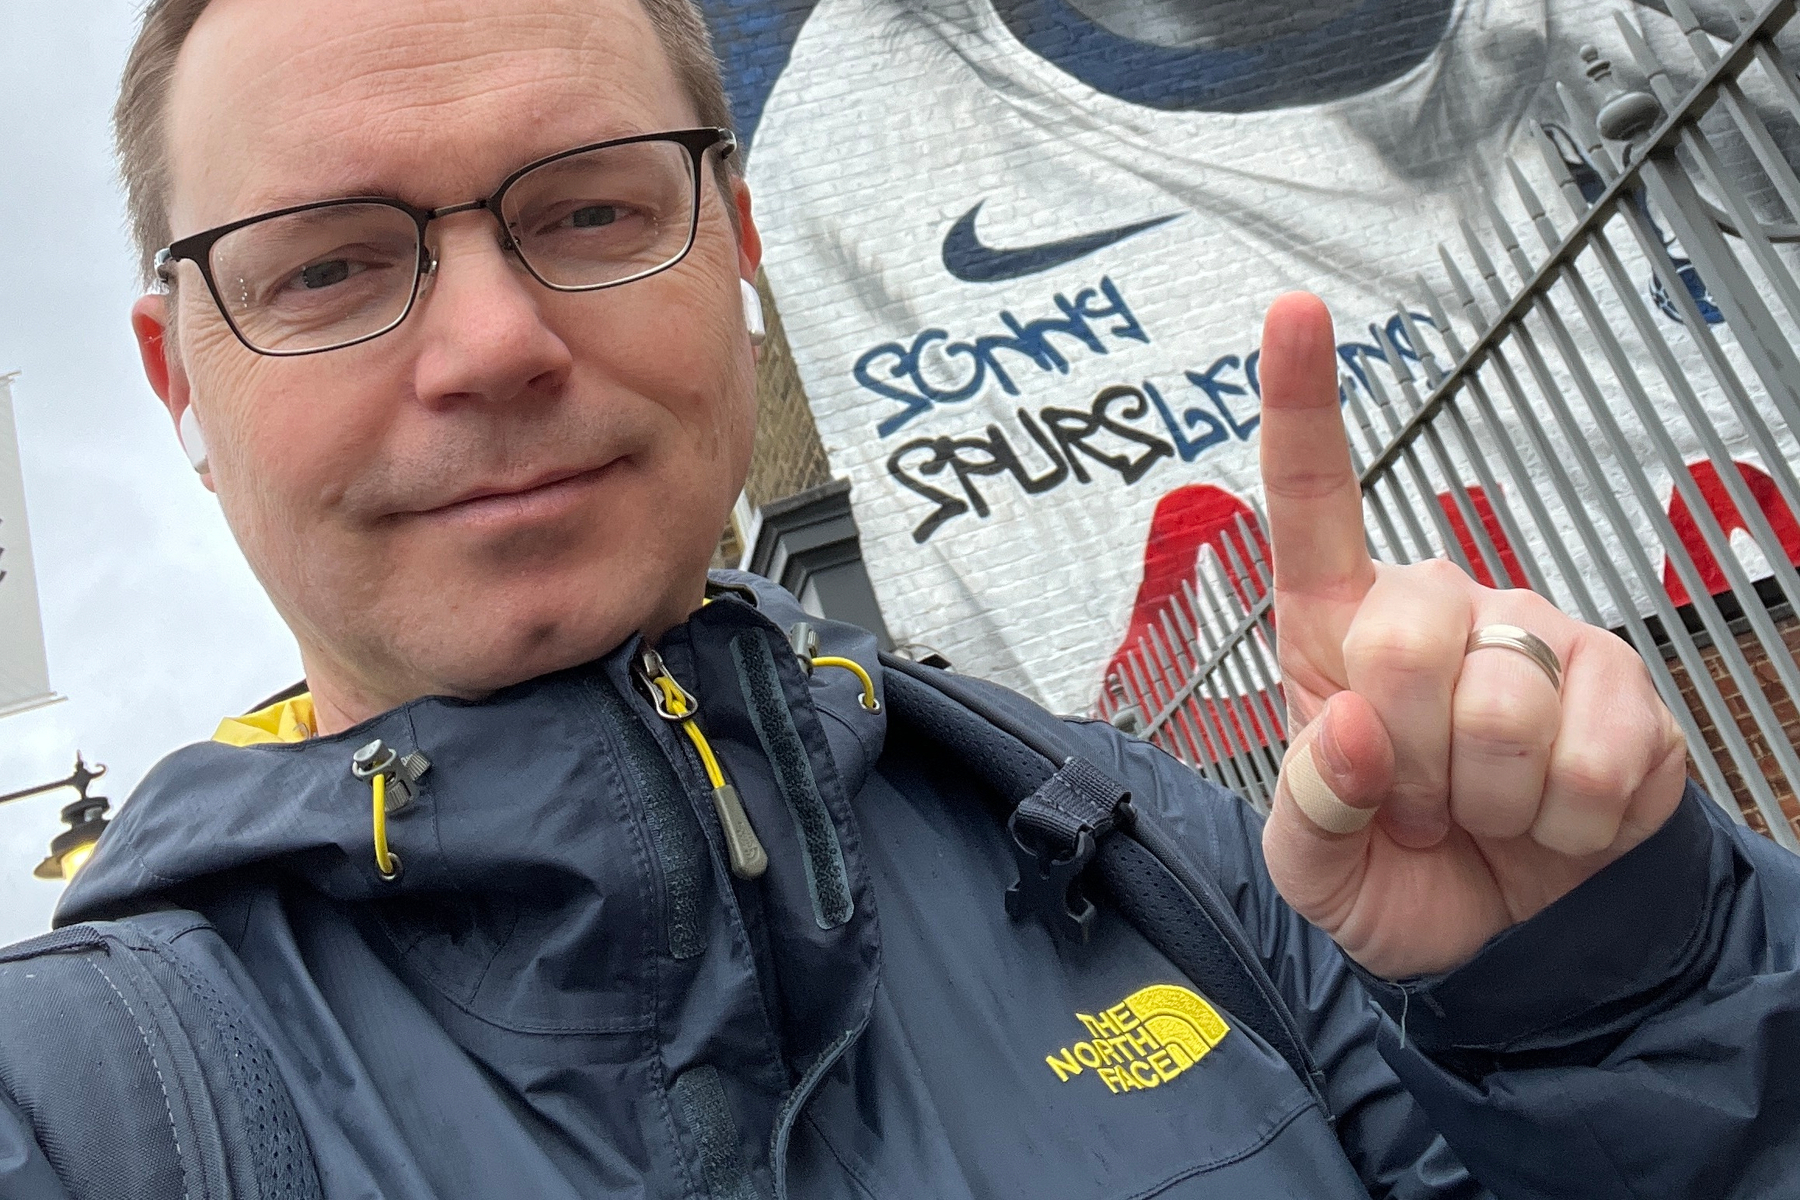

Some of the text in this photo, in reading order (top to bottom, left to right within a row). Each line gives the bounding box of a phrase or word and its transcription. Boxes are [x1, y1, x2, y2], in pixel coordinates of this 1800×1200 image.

[853, 275, 1150, 438] SONNY
[886, 385, 1175, 544] SPURS
[1075, 1001, 1142, 1039] THE
[1045, 1026, 1161, 1083] NORTH
[1097, 1049, 1183, 1094] FACE
